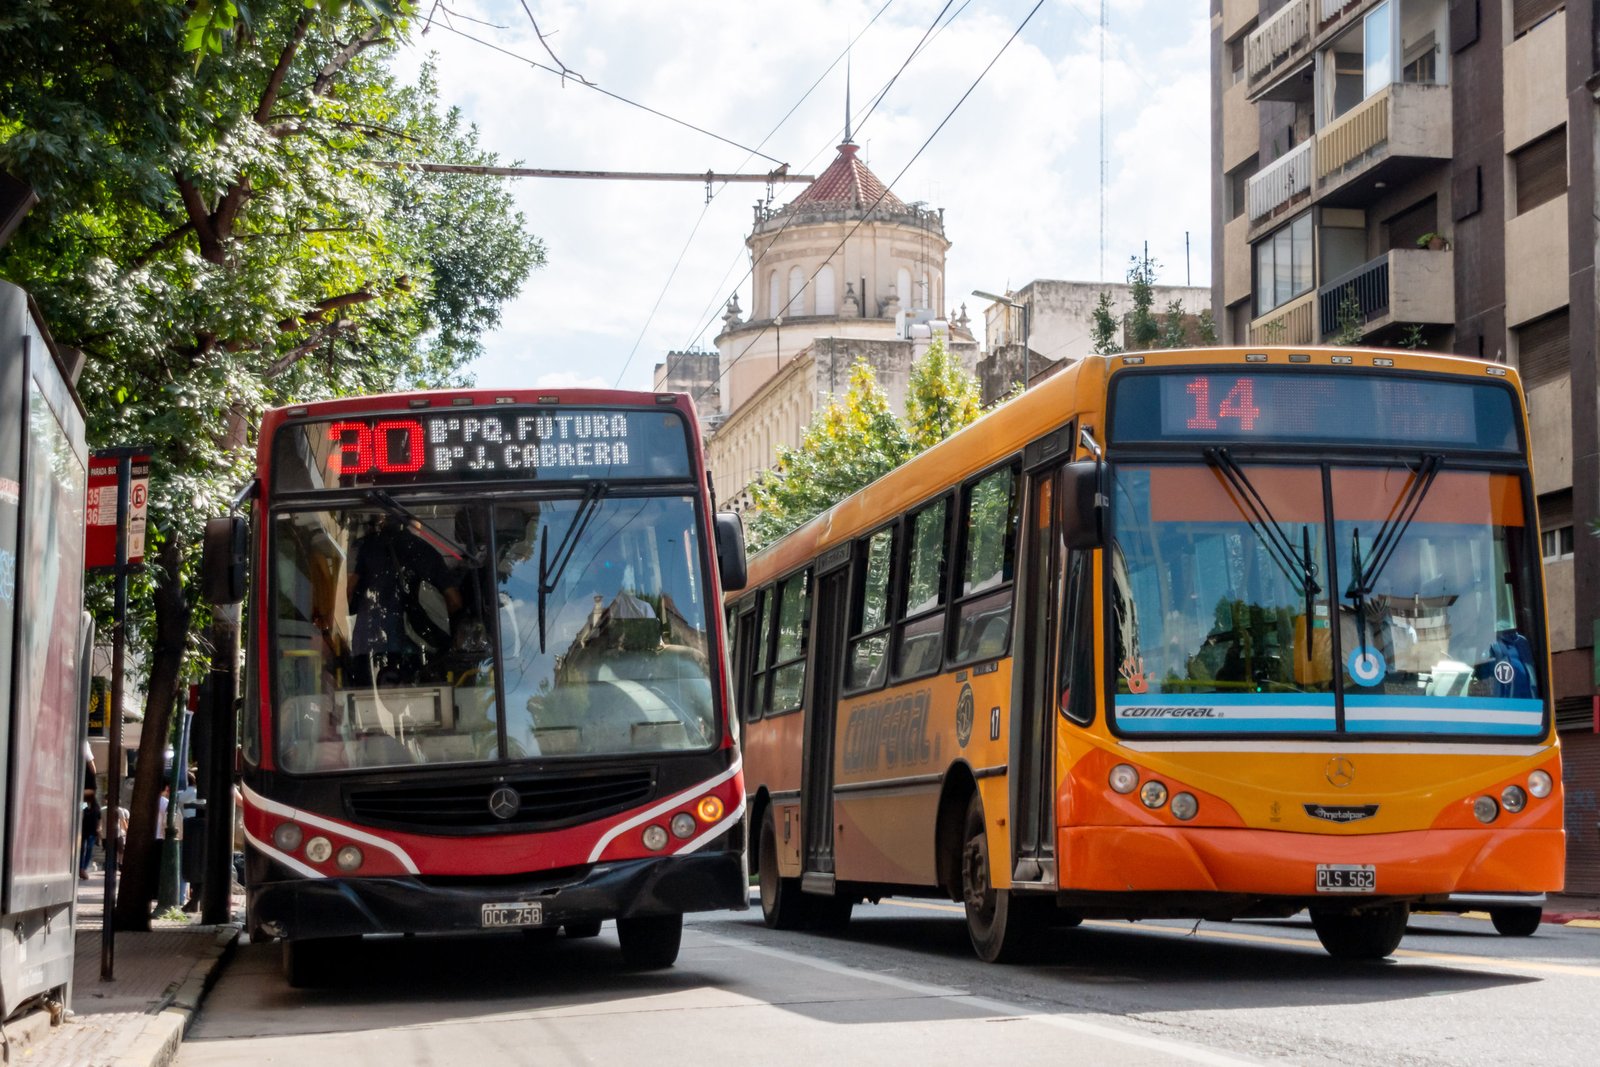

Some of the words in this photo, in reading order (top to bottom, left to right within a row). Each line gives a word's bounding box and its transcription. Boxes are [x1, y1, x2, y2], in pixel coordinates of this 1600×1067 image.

[1186, 375, 1260, 432] 14
[518, 414, 630, 440] FUTURA
[327, 418, 425, 475] 30
[467, 445, 496, 471] J.
[505, 442, 631, 468] CABRERA
[91, 467, 107, 476] PARADA
[108, 466, 117, 475] BUS
[88, 488, 99, 506] 35
[86, 507, 98, 525] 36
[1497, 665, 1510, 681] 17
[1318, 870, 1343, 887] PLS
[1349, 871, 1374, 887] 562
[515, 908, 540, 924] 758
